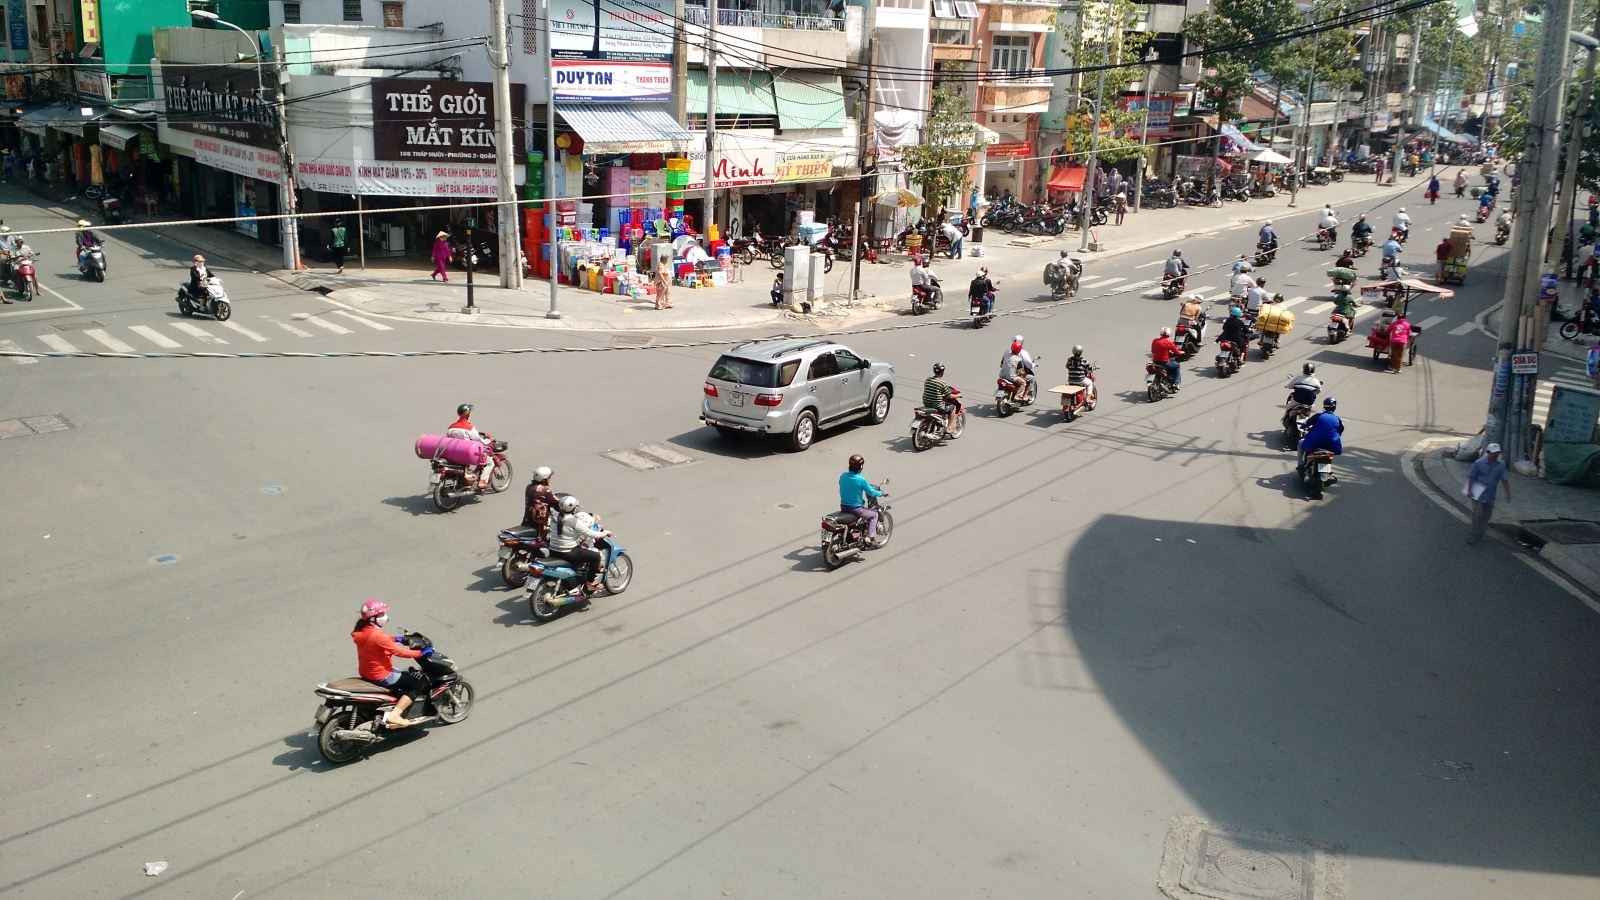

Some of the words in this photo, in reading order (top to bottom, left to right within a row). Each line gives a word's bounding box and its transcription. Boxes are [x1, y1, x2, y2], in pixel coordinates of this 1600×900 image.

[386, 84, 434, 113] THẾ
[439, 88, 487, 115] GIỚI
[406, 117, 453, 146] MẮT
[460, 122, 497, 147] KÍN
